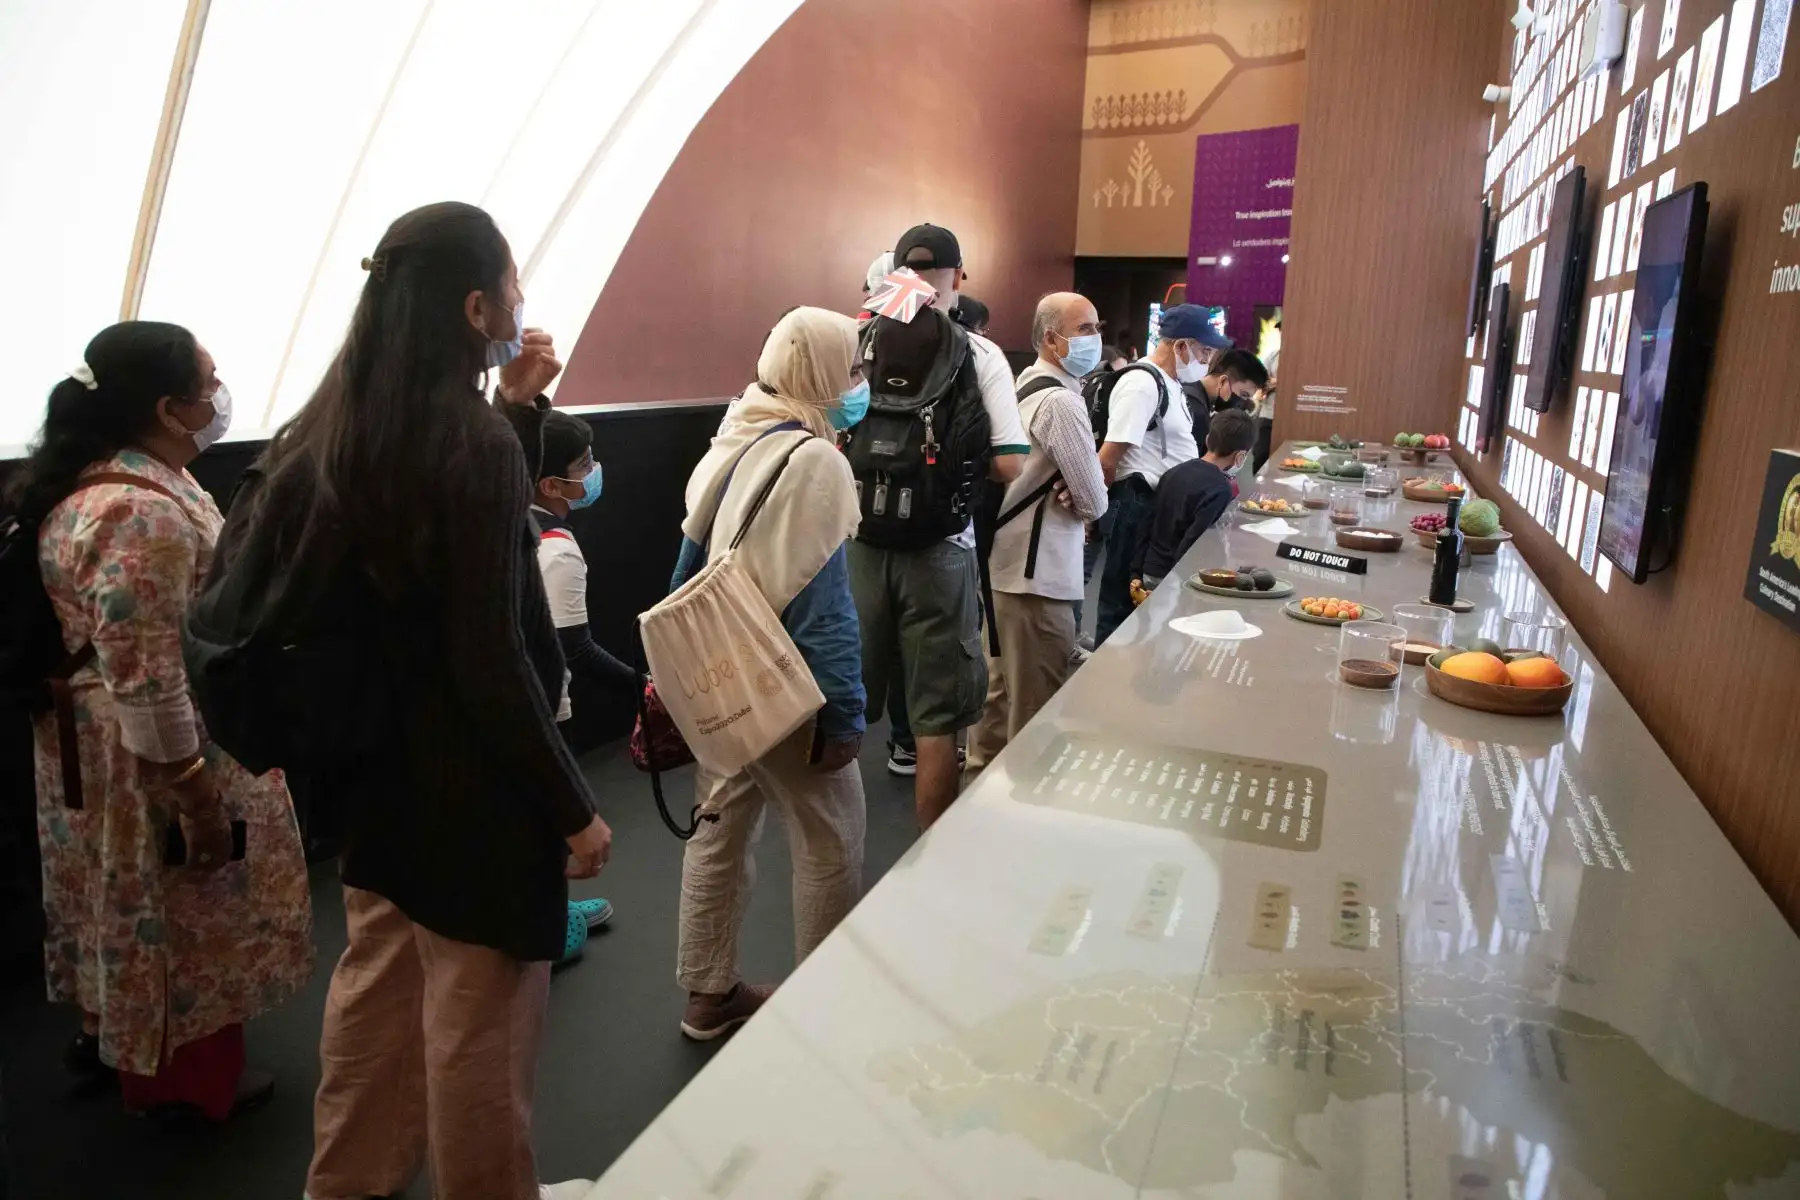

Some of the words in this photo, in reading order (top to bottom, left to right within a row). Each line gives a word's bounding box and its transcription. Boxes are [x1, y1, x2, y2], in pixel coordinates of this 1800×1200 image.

[1289, 547, 1302, 558] DO
[1303, 550, 1321, 561] NOT
[1321, 554, 1350, 568] TOUCH
